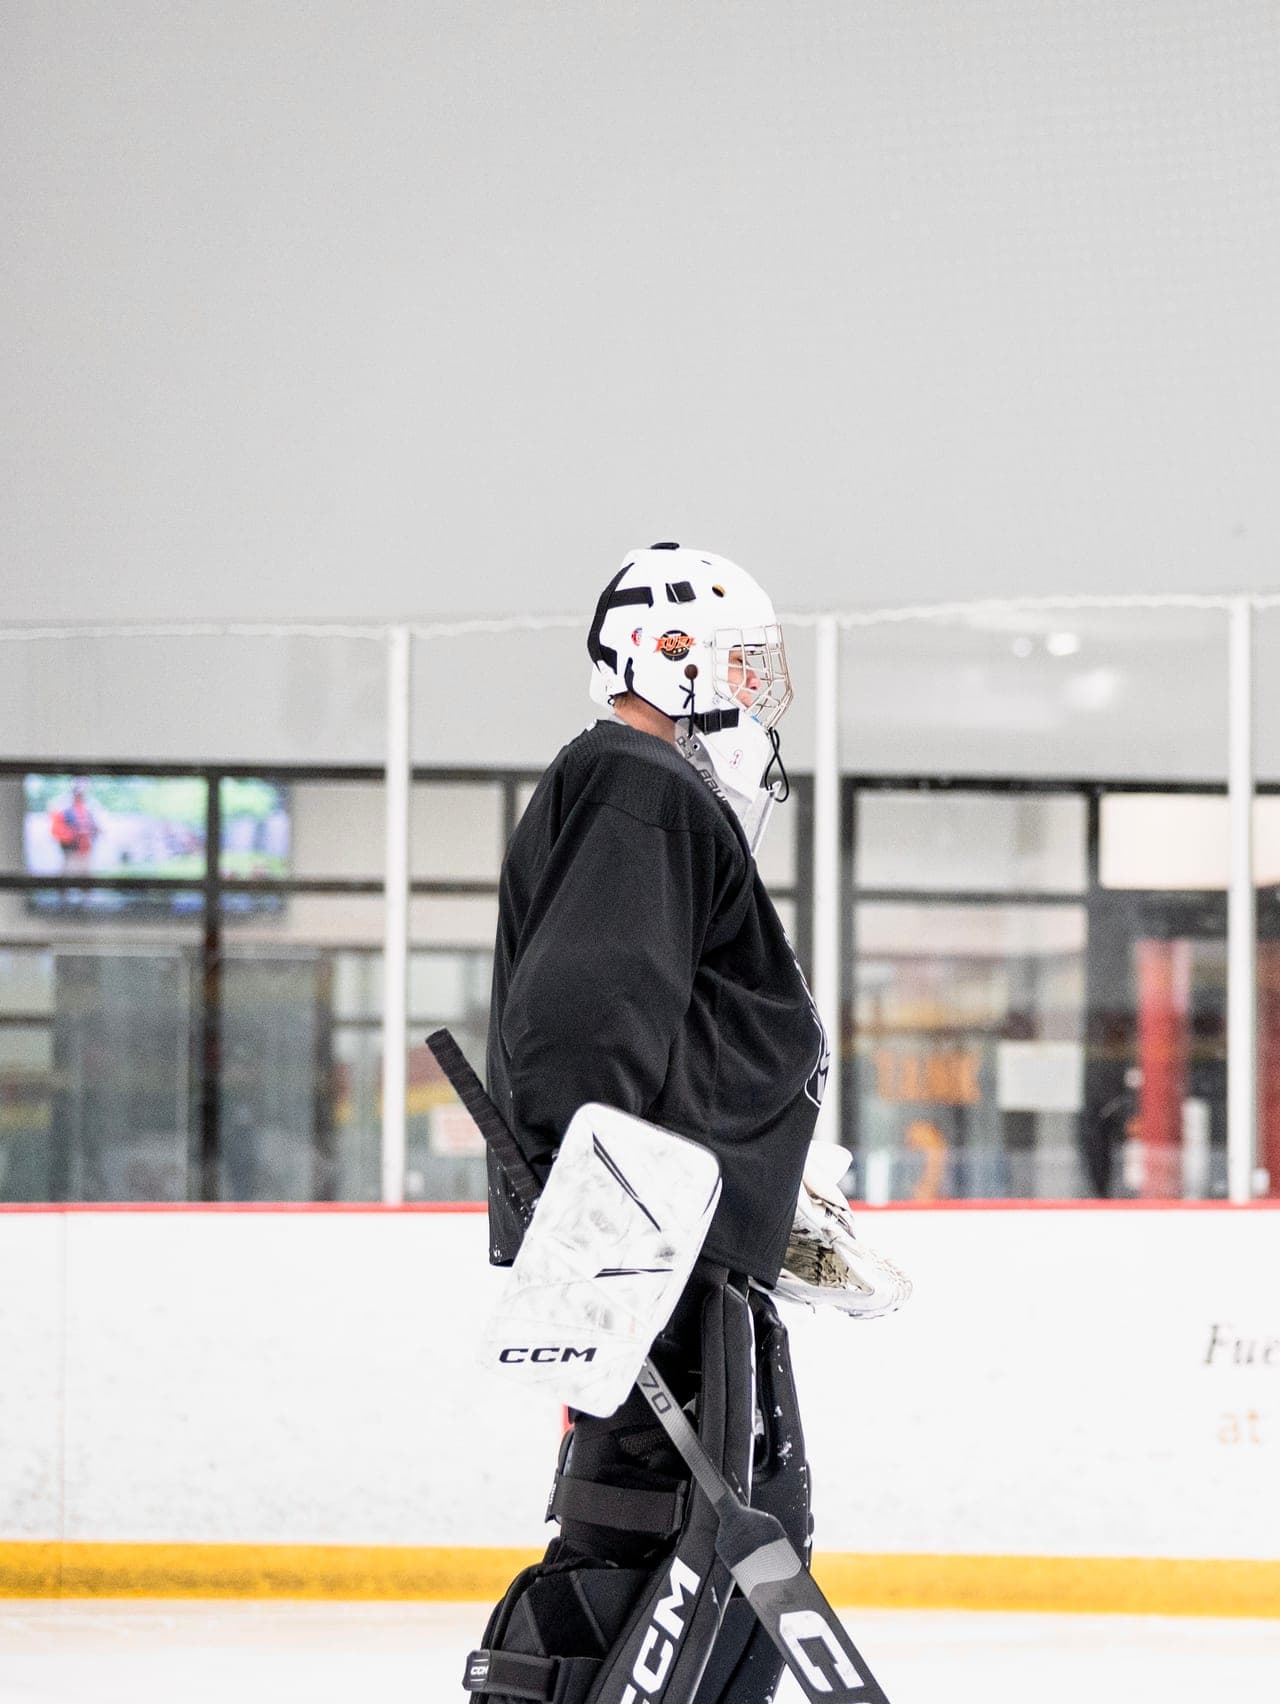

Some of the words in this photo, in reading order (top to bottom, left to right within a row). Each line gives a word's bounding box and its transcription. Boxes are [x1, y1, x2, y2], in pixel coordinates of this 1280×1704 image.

[498, 1346, 598, 1365] CCM
[641, 1370, 672, 1414] 70
[1216, 1408, 1262, 1447] at
